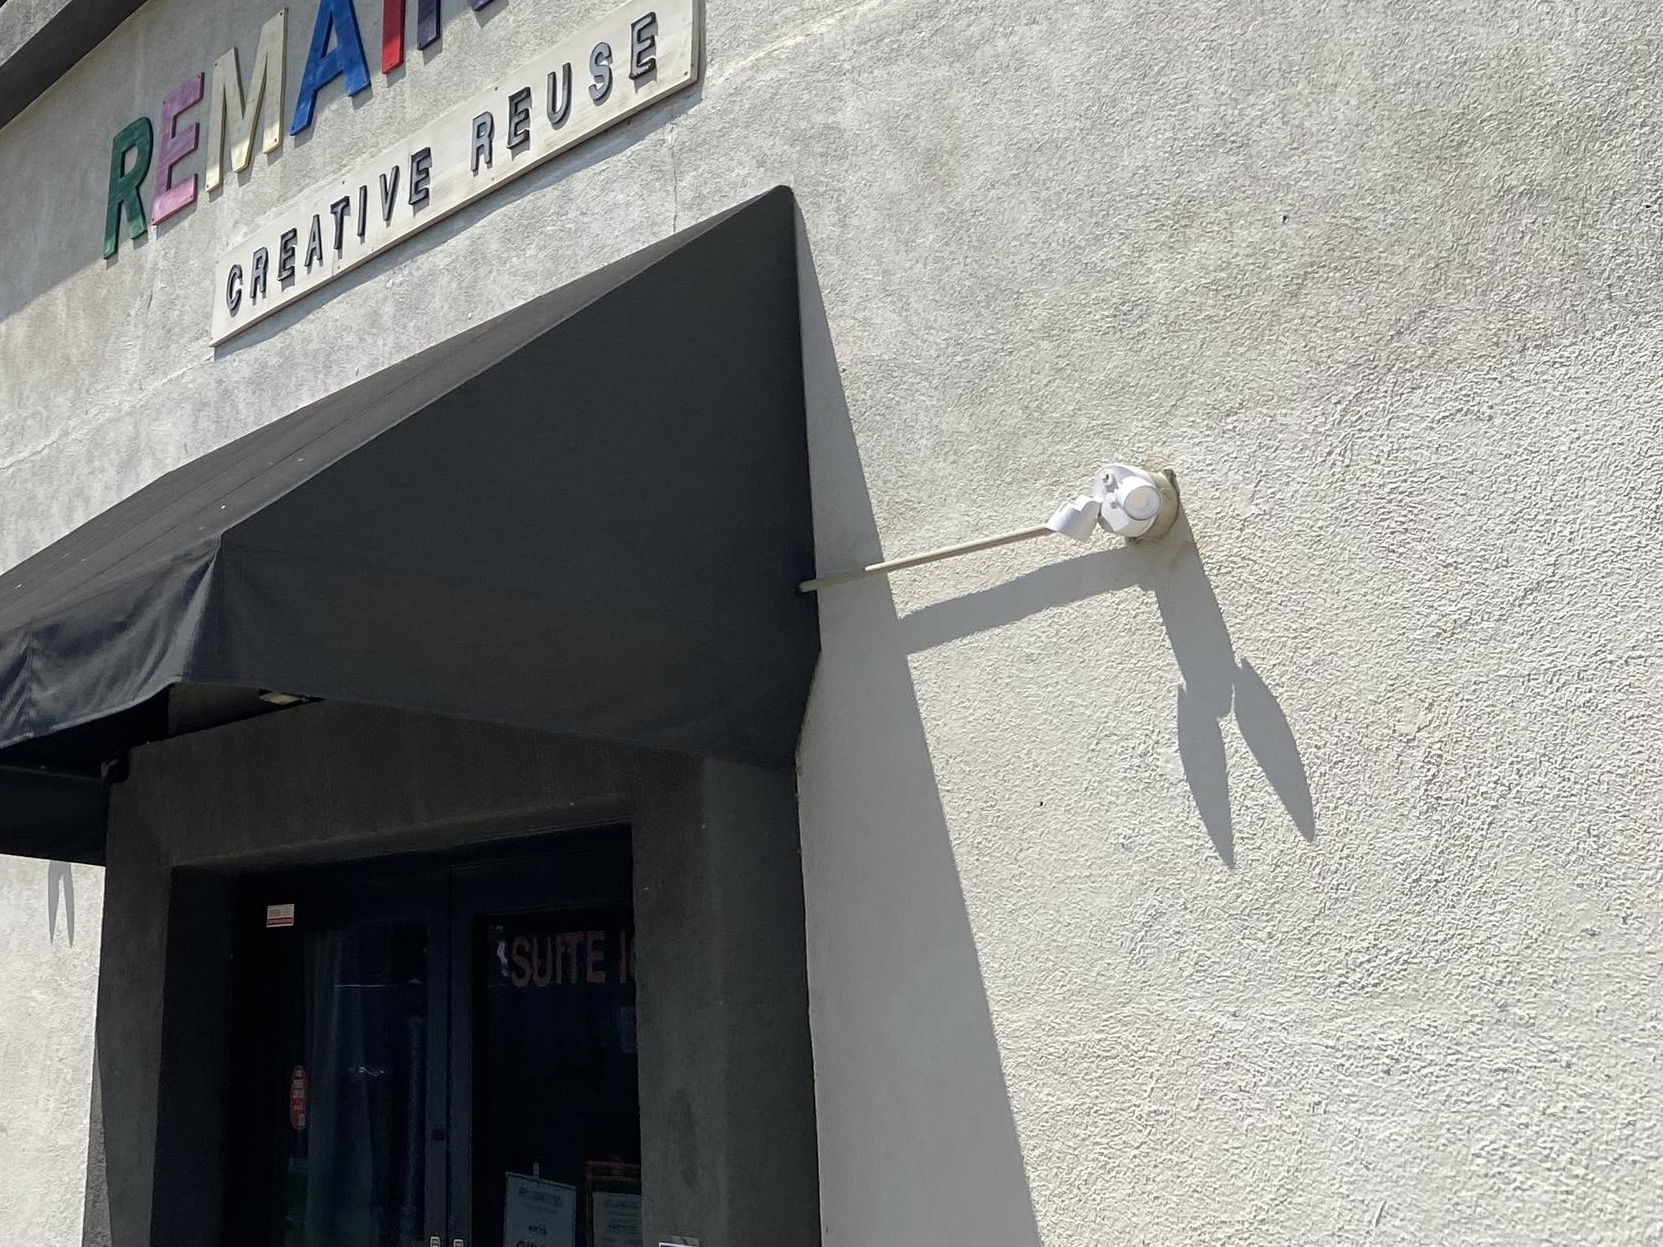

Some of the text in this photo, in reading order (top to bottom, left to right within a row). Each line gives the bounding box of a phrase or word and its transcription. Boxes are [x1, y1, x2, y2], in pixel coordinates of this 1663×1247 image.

[226, 10, 657, 316] CREATIVE REUSE
[510, 930, 607, 989] SUITE
